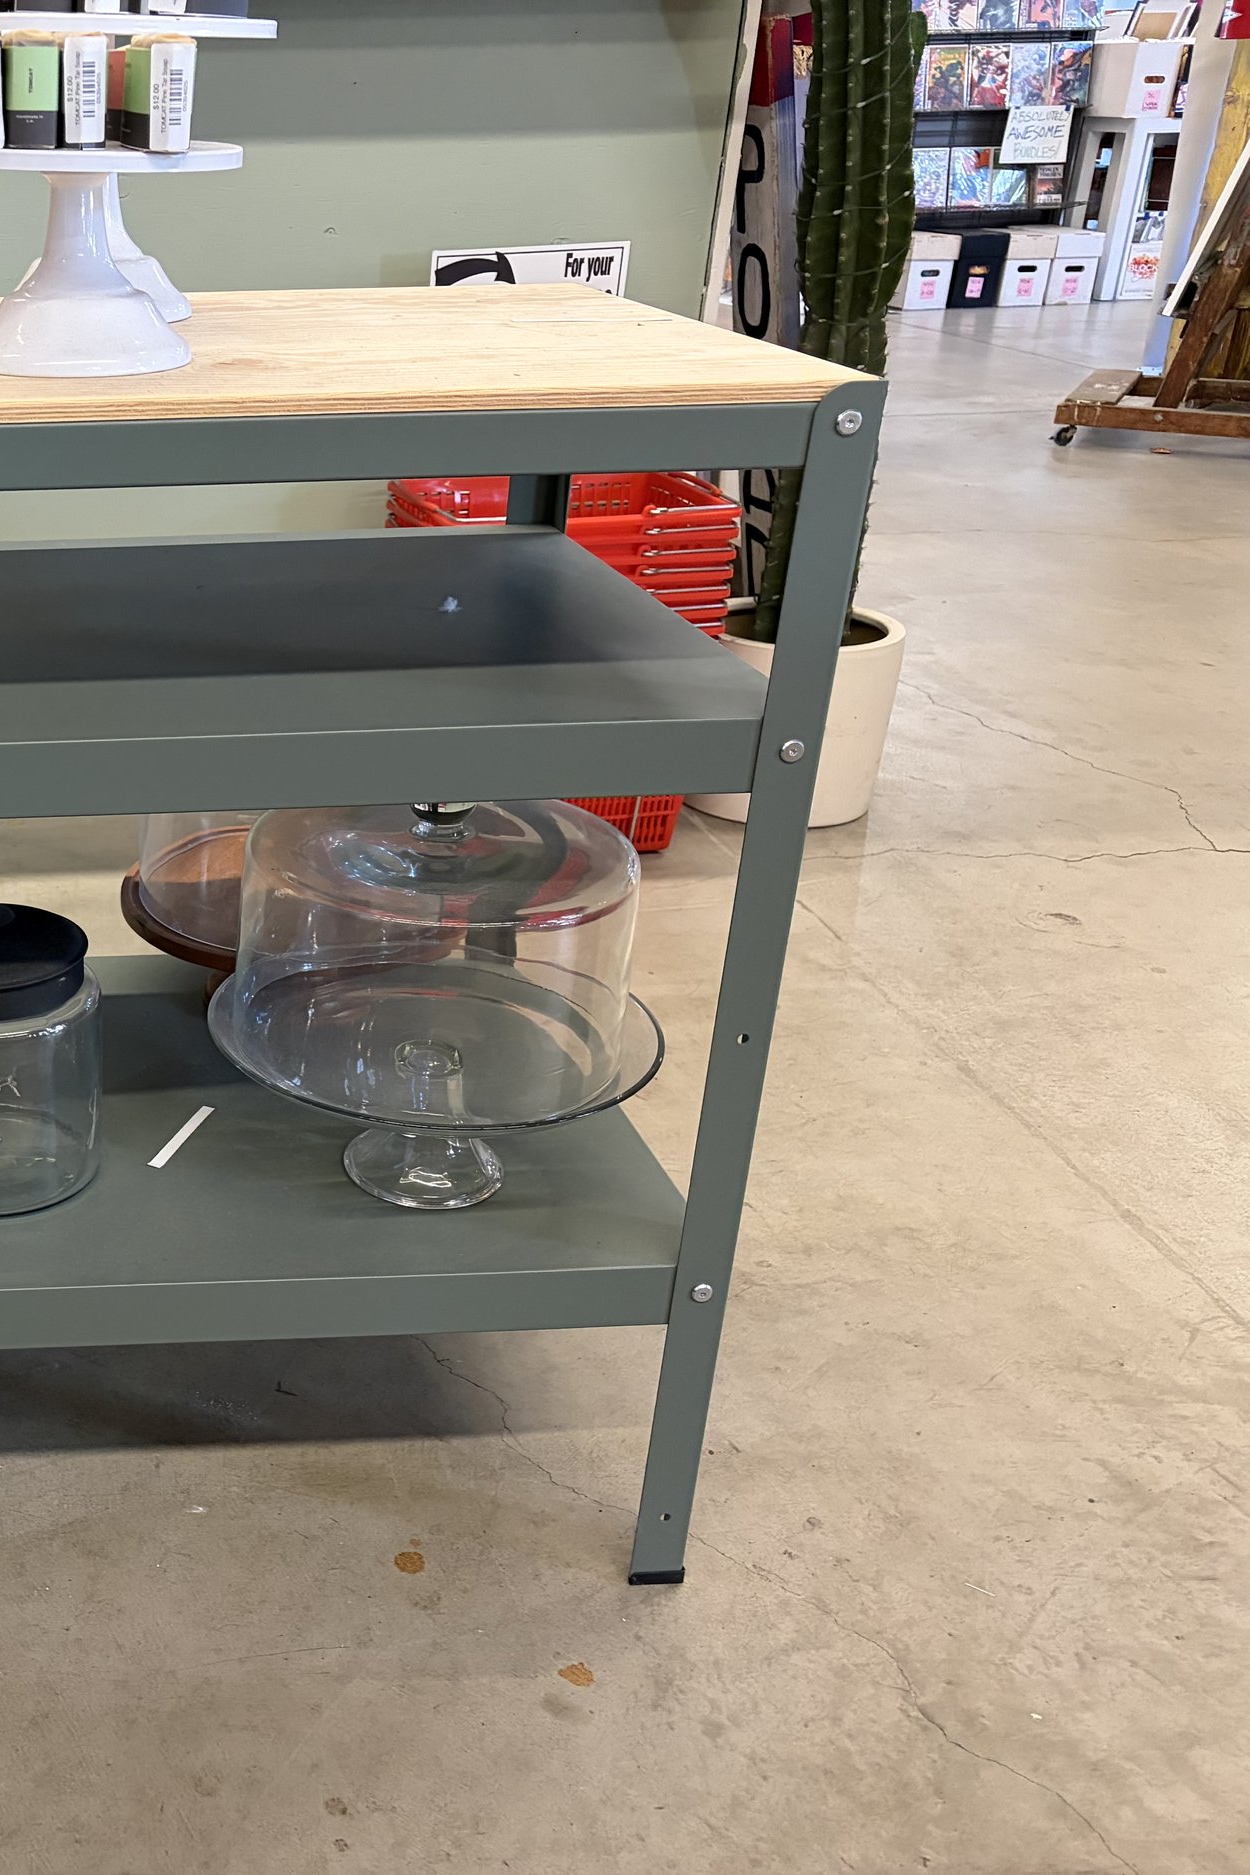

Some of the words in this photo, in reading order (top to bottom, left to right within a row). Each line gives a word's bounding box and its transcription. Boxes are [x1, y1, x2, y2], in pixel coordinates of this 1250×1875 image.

[66, 75, 74, 102] $12.00
[152, 83, 160, 110] $12.00
[1007, 124, 1066, 141] AWESOME
[564, 253, 585, 278] For
[587, 255, 615, 282] your
[1129, 264, 1159, 272] BLOCK
